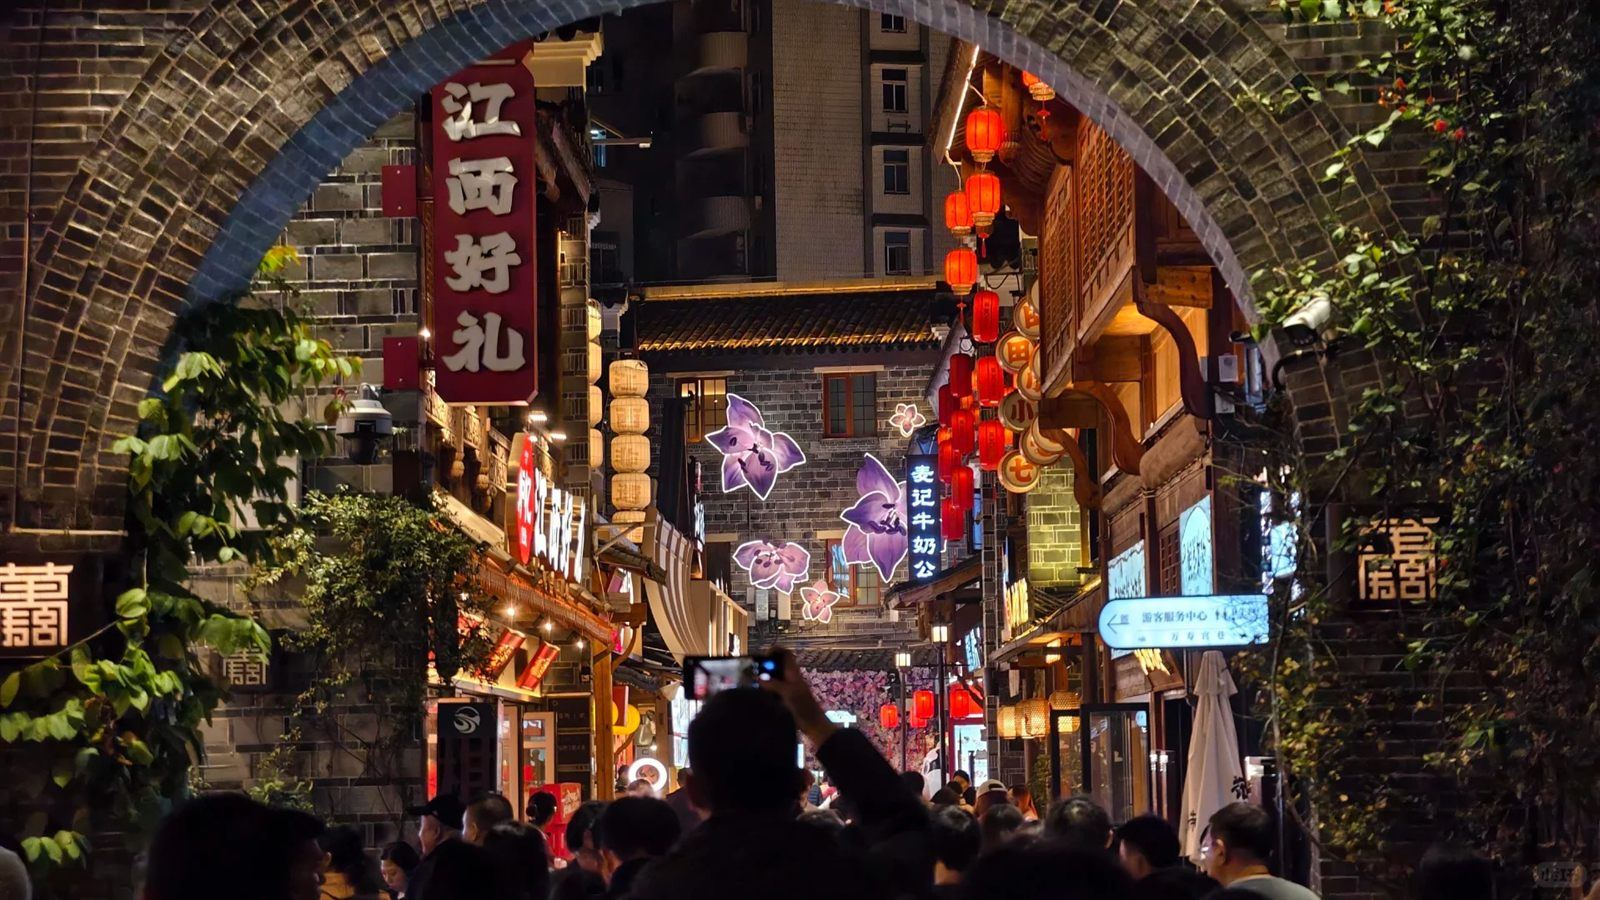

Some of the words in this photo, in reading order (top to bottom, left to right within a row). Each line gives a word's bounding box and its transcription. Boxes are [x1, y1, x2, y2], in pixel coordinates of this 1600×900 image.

[441, 82, 526, 373] 江西好礼
[910, 465, 936, 579] 麦记牛奶公
[1142, 608, 1208, 624] 游客服务中心
